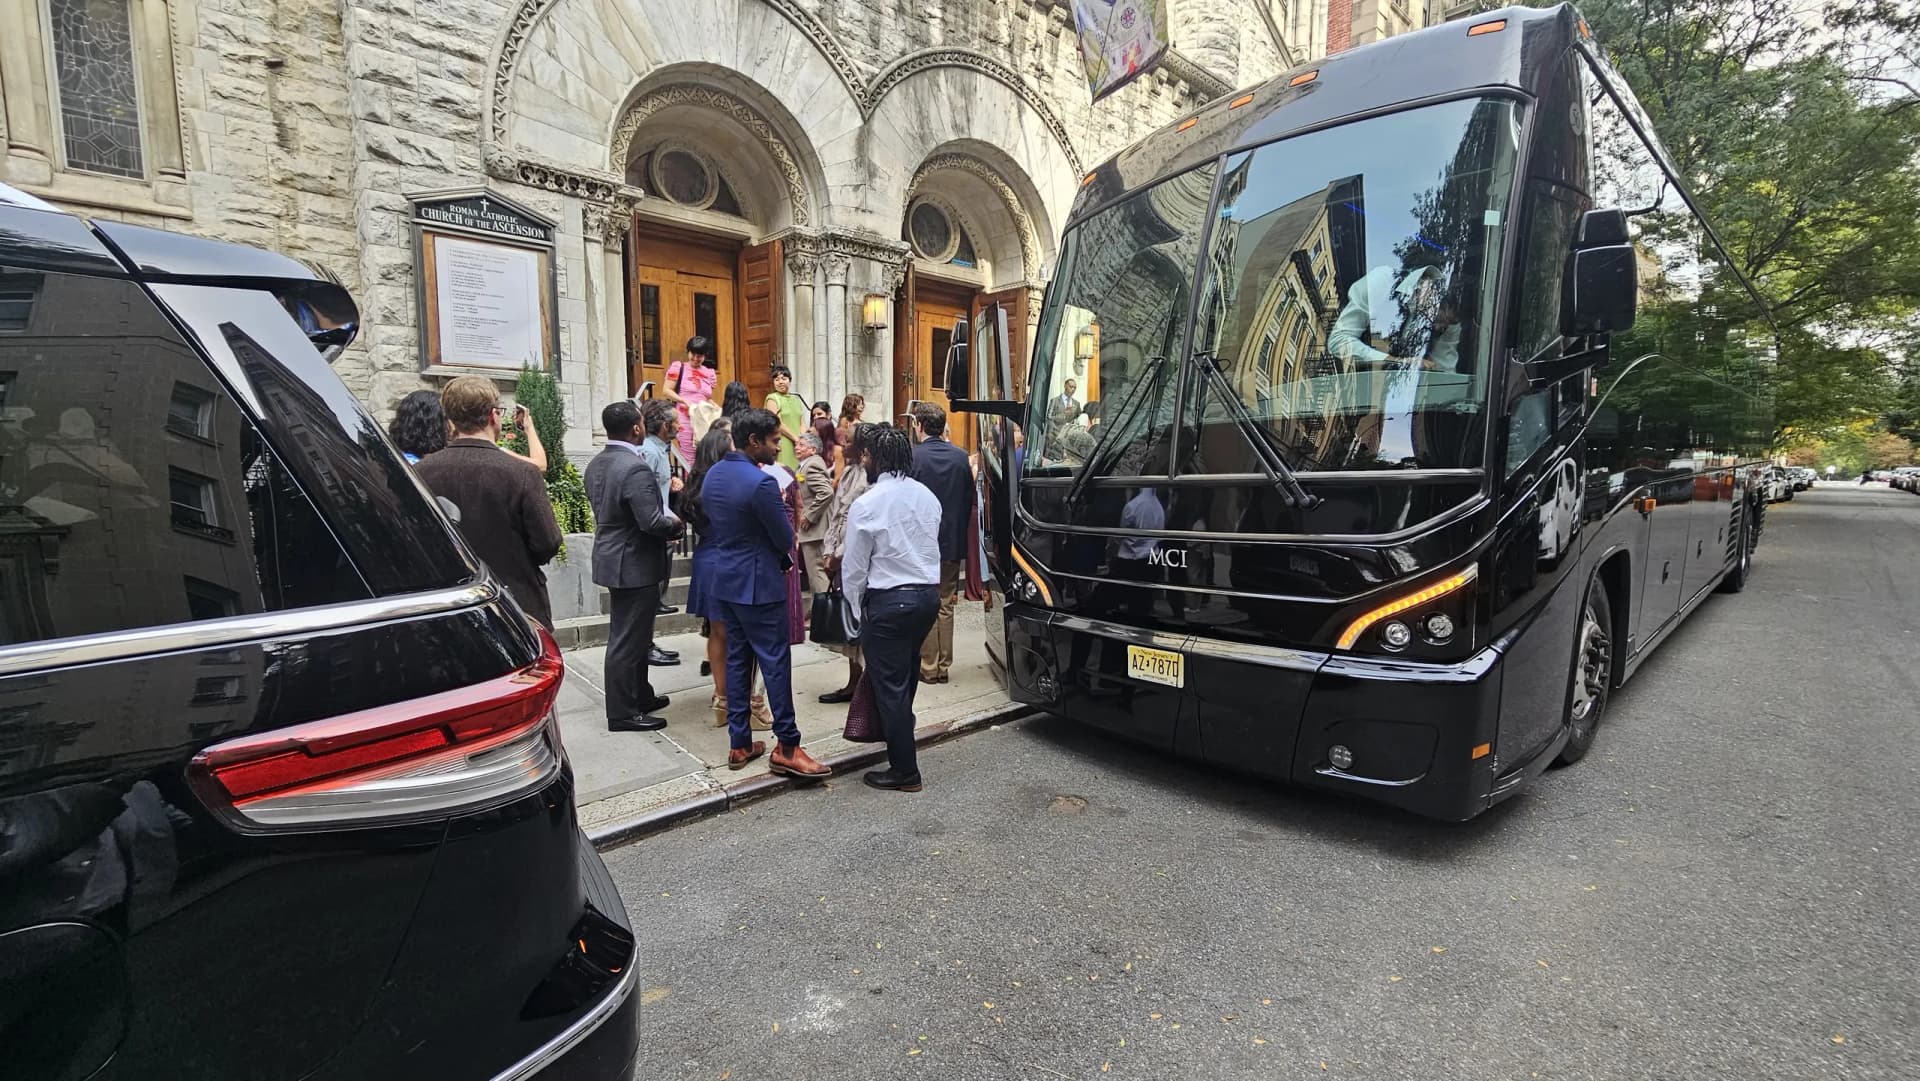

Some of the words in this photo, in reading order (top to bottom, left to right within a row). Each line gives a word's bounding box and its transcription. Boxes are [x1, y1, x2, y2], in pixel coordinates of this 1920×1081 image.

[421, 207, 463, 225] CHURCH
[464, 218, 474, 227] OF
[476, 219, 491, 230] THE
[492, 220, 545, 239] ASCENSION
[450, 204, 479, 217] ROMAN
[480, 210, 519, 224] CATHOLIC
[1147, 546, 1188, 568] MCI
